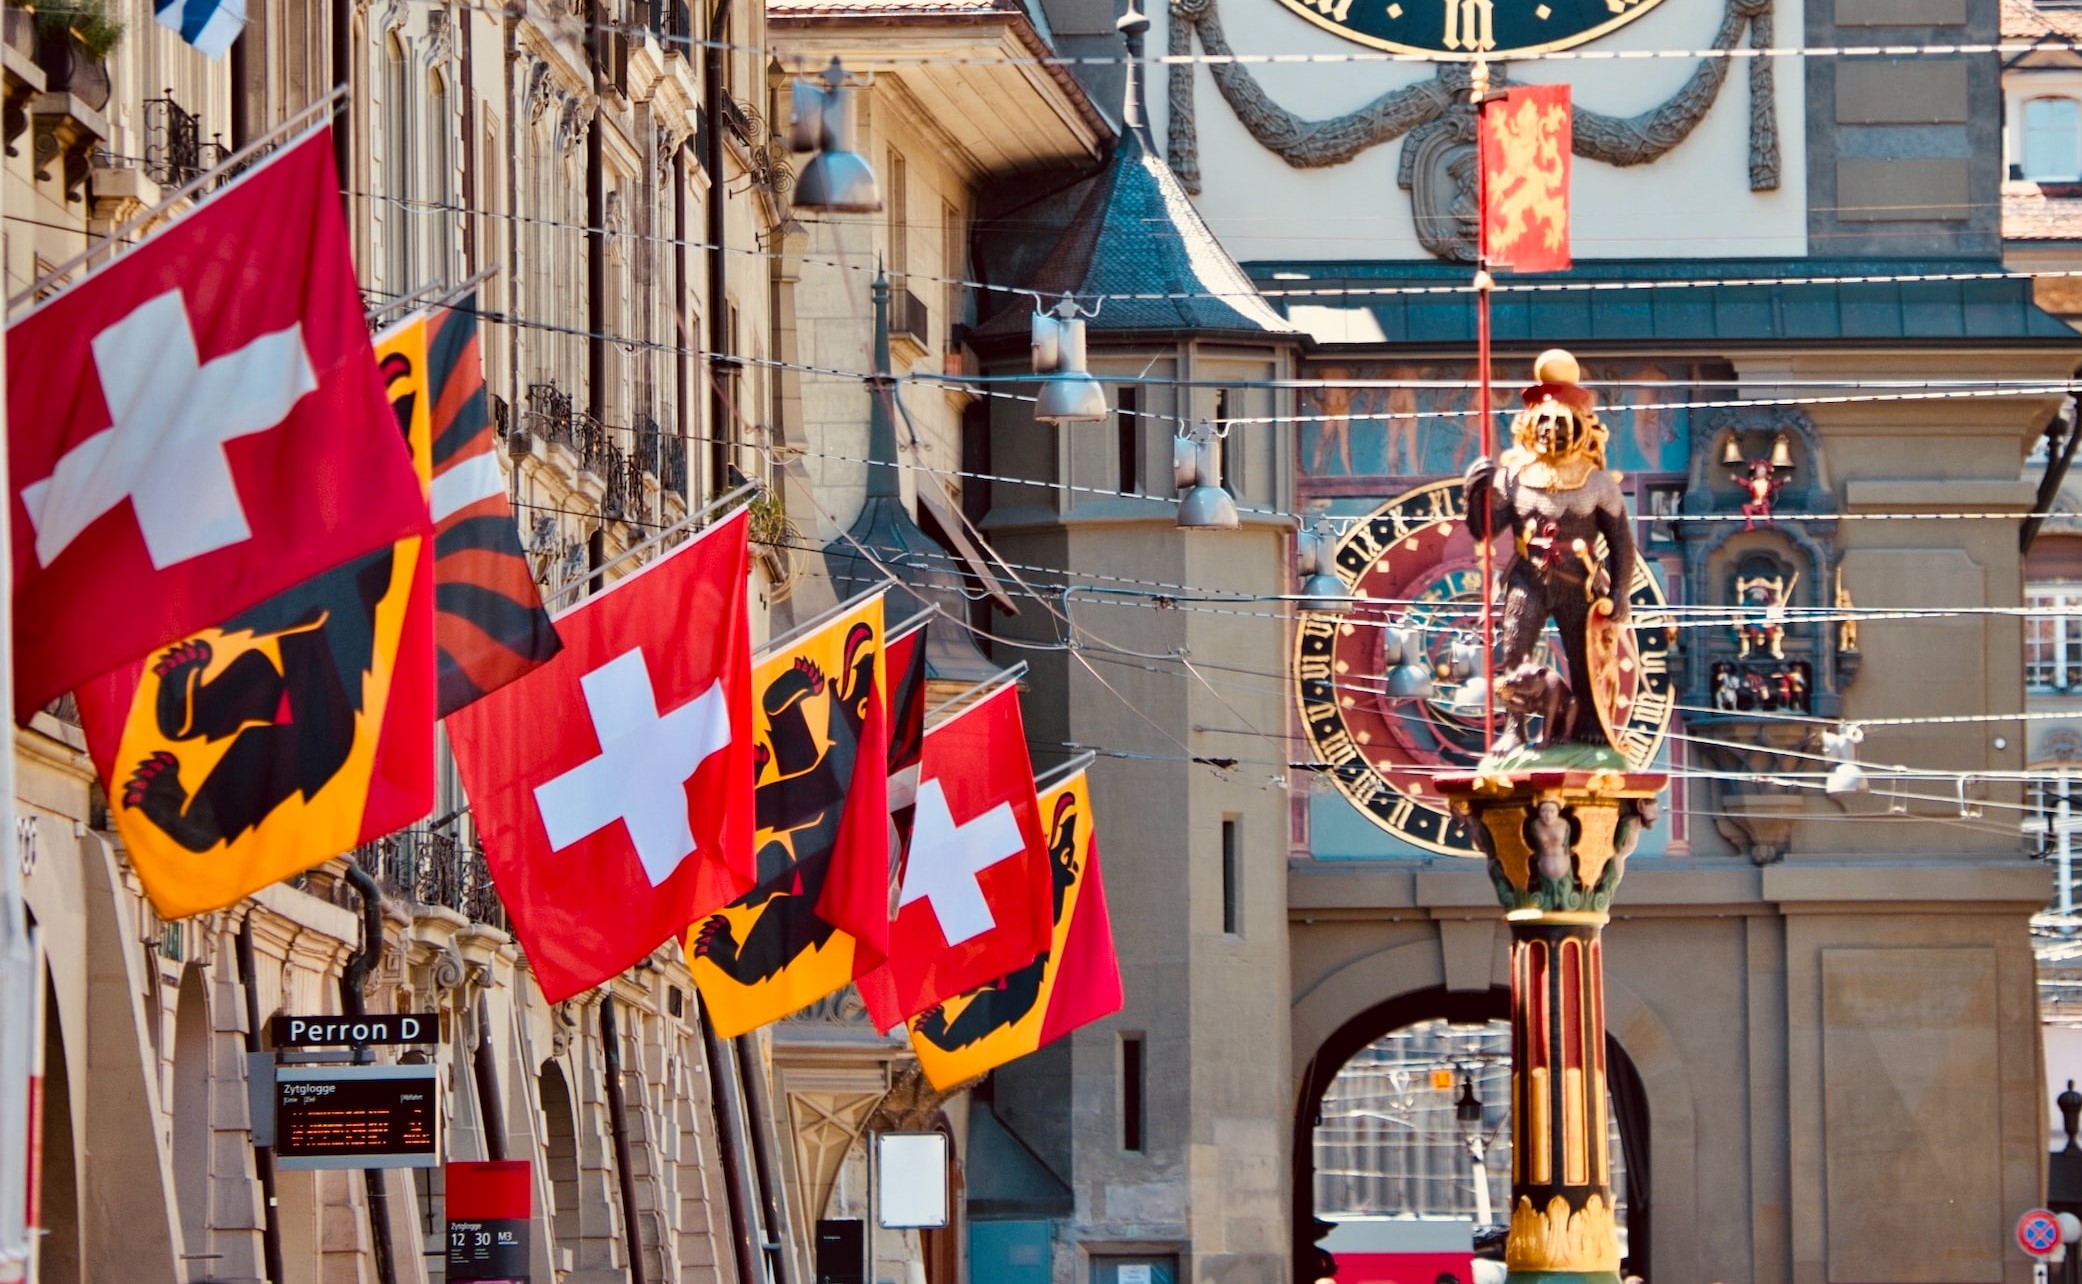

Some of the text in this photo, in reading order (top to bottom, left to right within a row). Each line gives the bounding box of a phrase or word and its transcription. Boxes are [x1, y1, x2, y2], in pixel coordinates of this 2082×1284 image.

[290, 1018, 420, 1042] Perron D
[283, 1083, 337, 1096] Zytglogge
[450, 1222, 482, 1232] Zytglogge
[451, 1231, 513, 1247] 12 30 M3
